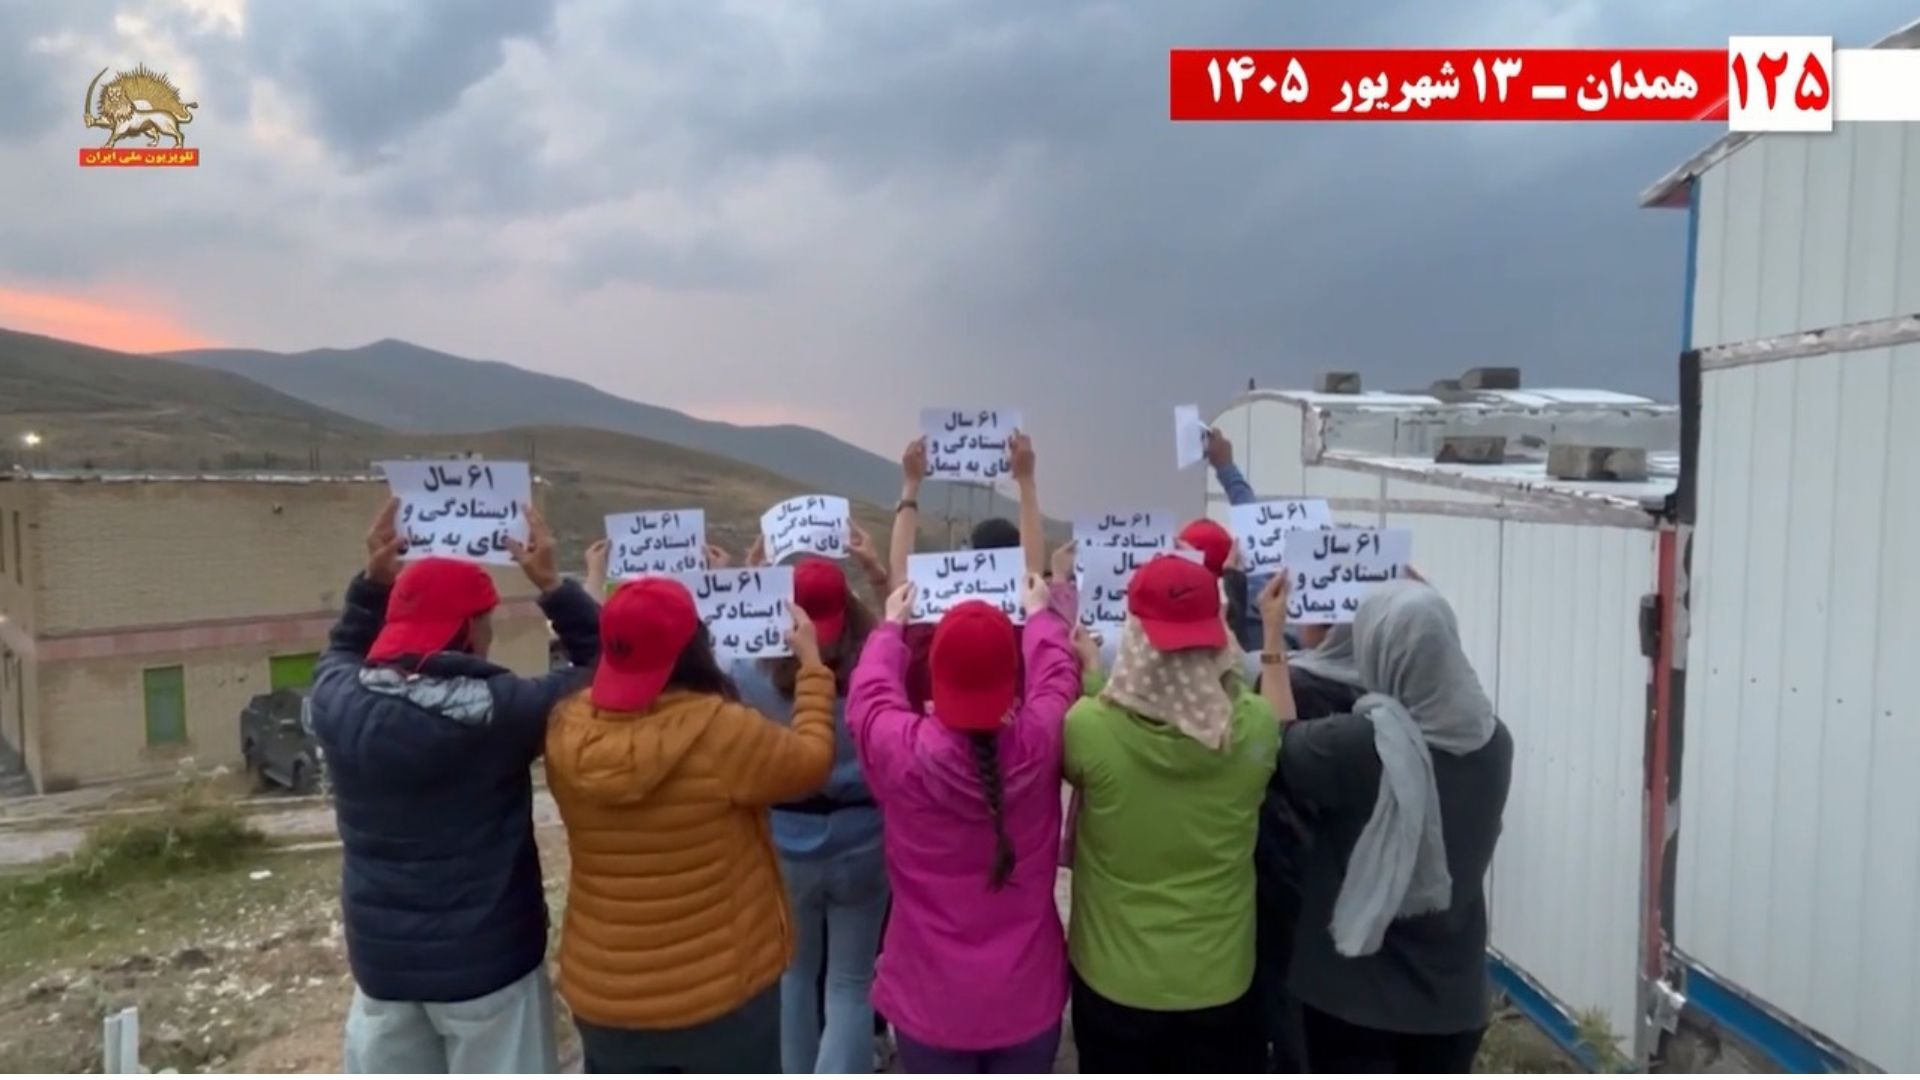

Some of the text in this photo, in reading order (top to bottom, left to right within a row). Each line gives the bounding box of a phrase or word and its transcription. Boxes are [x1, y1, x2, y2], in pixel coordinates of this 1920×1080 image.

[945, 410, 997, 431] ۶۱ سال
[931, 440, 939, 454] و
[424, 465, 494, 492] ۶۱ سال
[966, 460, 979, 476] به
[984, 457, 1011, 478] فای
[402, 498, 517, 524] ایستادگی و
[777, 503, 802, 521] سال
[1098, 513, 1151, 531] ۶۱ سال
[1256, 503, 1307, 525] ۶۱ سال
[630, 512, 680, 535] ۶۱ سال
[441, 533, 461, 553] به
[619, 534, 696, 557] ایستادگی و
[1103, 533, 1165, 547] ایستادگ
[1313, 535, 1351, 559] سال
[1355, 533, 1380, 555] ۶۱
[652, 560, 665, 571] به
[936, 553, 996, 578] ۶۱ سال
[697, 571, 761, 598] ۶۱ سال
[1297, 564, 1397, 590] ایستادگی و
[922, 578, 1015, 600] ایستادگی و
[1000, 600, 1026, 621] وفا
[1080, 603, 1126, 627] پیمان
[1287, 594, 1359, 619] به پیمان
[722, 633, 739, 654] به
